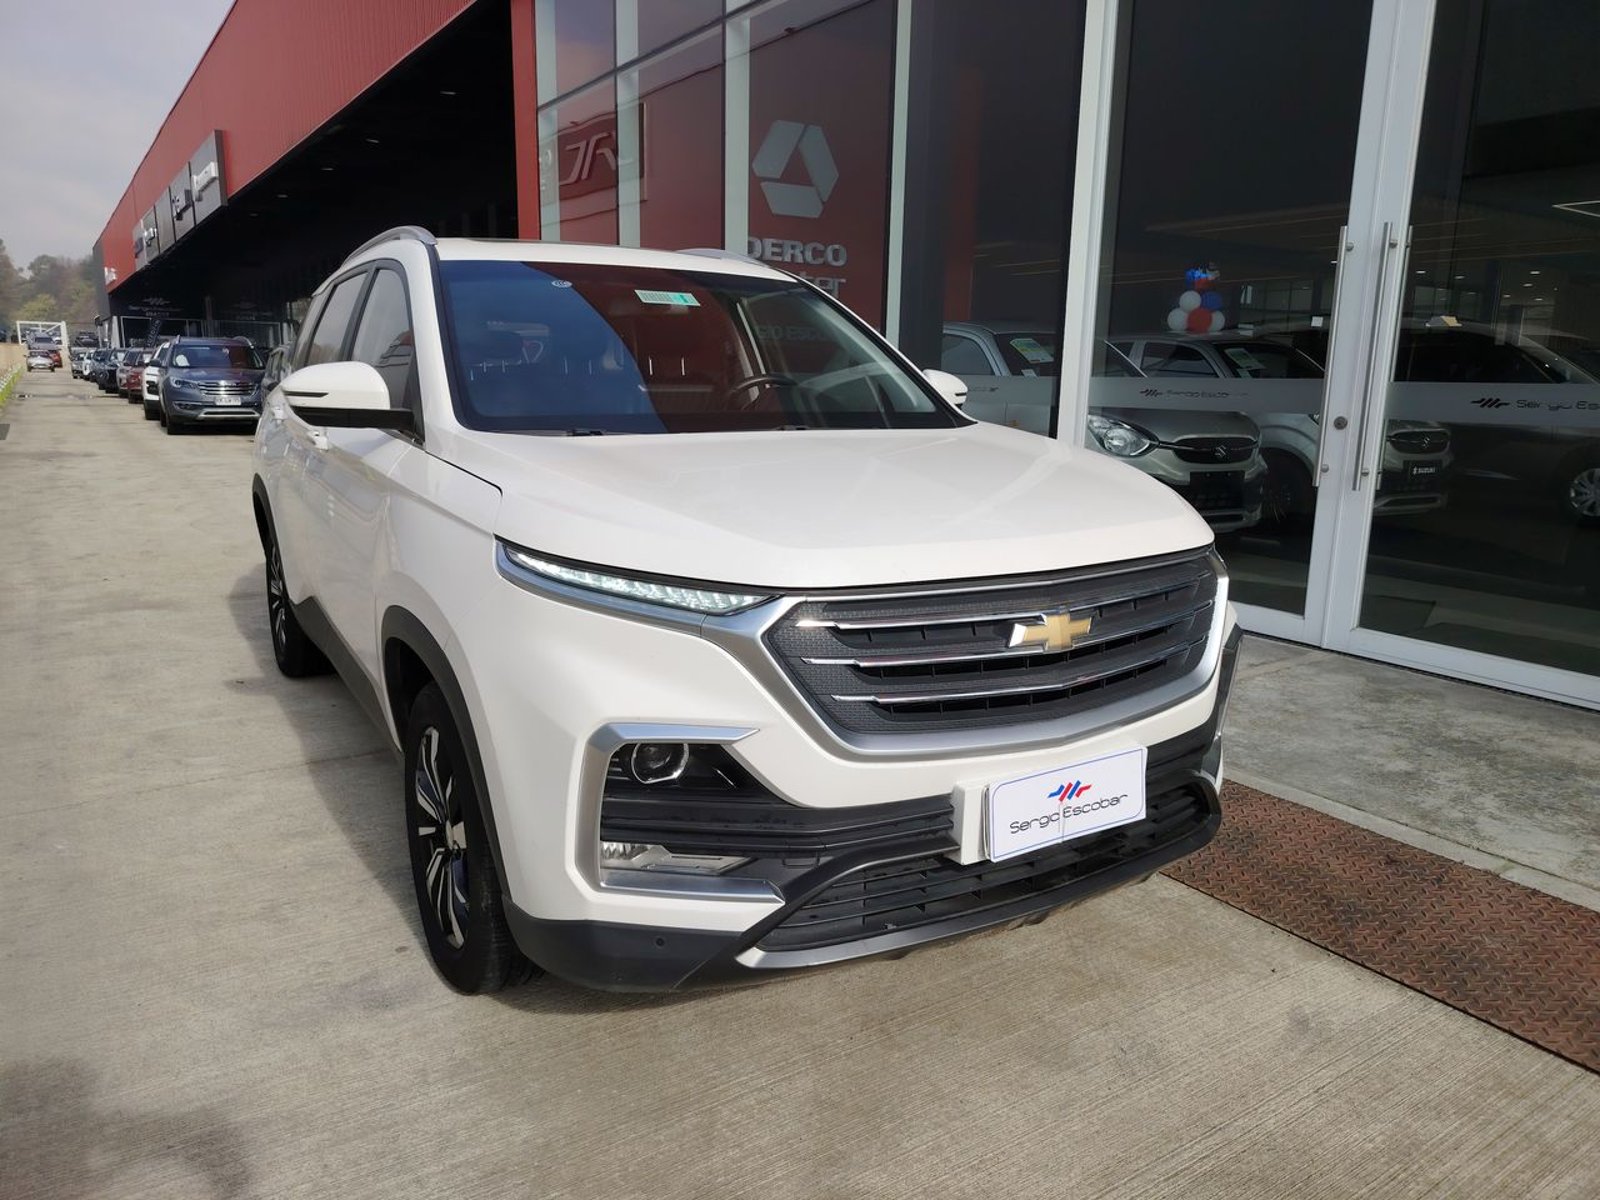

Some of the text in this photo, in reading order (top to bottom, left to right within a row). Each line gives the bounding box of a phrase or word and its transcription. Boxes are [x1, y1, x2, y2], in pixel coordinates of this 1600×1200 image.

[747, 236, 847, 266] DERCO
[1009, 794, 1128, 834] Sergio Escobar
